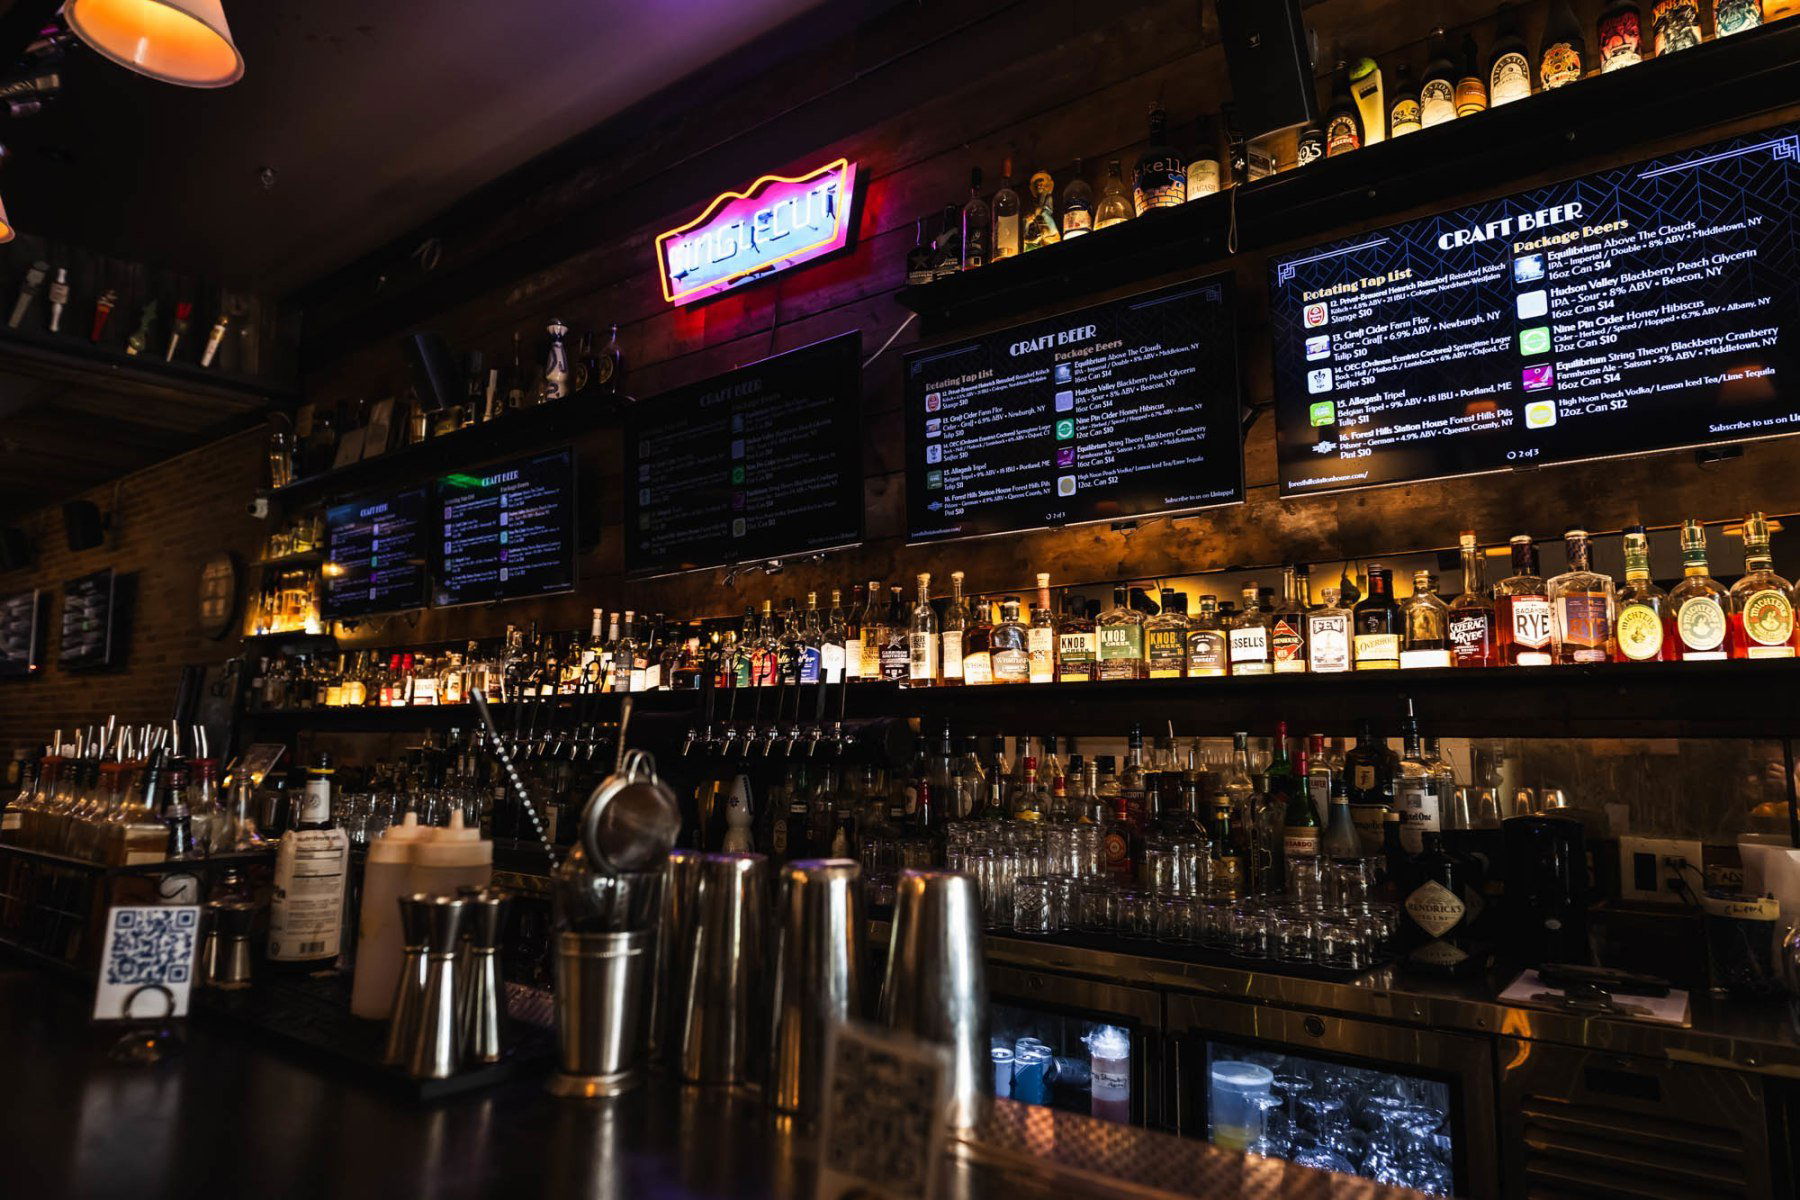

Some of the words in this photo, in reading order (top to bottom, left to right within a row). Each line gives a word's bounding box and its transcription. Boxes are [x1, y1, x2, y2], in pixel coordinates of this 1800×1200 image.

[1437, 217, 1513, 250] CRAFT
[1517, 201, 1583, 232] BEER
[1513, 230, 1580, 253] Package
[1582, 219, 1629, 238] Beers
[1547, 242, 1602, 260] Equilibrium
[1603, 235, 1636, 248] Above
[1636, 230, 1656, 240] The
[1657, 220, 1696, 236] Clouds
[1548, 270, 1570, 280] 16oz
[1571, 265, 1592, 275] Can
[1593, 259, 1611, 271] $14
[1549, 283, 1587, 297] Hudson
[1587, 277, 1618, 289] Valley
[1620, 266, 1674, 283] Blackberry
[1676, 257, 1709, 271] Peach
[1302, 280, 1359, 302] Rotating
[1358, 275, 1386, 288] Tap
[1387, 267, 1412, 282] List
[1550, 296, 1570, 308] IPA
[1577, 292, 1601, 303] Sour
[1609, 285, 1627, 296] 8%
[1628, 279, 1653, 293] ABV
[1661, 272, 1704, 286] Beacon,
[1705, 265, 1722, 277] NY
[1551, 309, 1573, 319] 16oz
[1574, 304, 1595, 314] Can
[1596, 298, 1615, 311] $14
[1552, 324, 1576, 334] Nine
[1577, 319, 1594, 330] Pin
[1595, 314, 1625, 326] Cider
[1626, 308, 1659, 320] Honey
[1660, 300, 1705, 314] Hibiscus
[1009, 333, 1055, 356] CRAFT
[1057, 324, 1096, 345] BEER
[1332, 341, 1355, 351] Cider
[1411, 323, 1432, 336] ABV
[1438, 314, 1485, 330] Newburgh,
[1486, 310, 1501, 321] NY
[1054, 346, 1094, 361] Package
[1095, 339, 1123, 352] Beers
[1554, 343, 1575, 352] 12oz
[1576, 338, 1598, 348] Can
[1599, 333, 1617, 345] $10
[1555, 356, 1607, 371] Equilibrium
[1607, 351, 1635, 362] String
[1636, 345, 1669, 356] Theory
[1670, 336, 1724, 351] Blackberry
[1724, 327, 1778, 341] Cranberry
[1333, 351, 1352, 361] Tulip
[1352, 347, 1368, 358] $10
[1557, 381, 1579, 390] 16oz
[1579, 376, 1601, 386] Can
[1602, 372, 1621, 383] $14
[1336, 399, 1347, 408] 15.
[1348, 392, 1382, 406] Allagash
[1382, 388, 1405, 400] Tripel
[1337, 408, 1364, 417] Belgian
[1363, 402, 1384, 413] Tripel
[1389, 400, 1403, 409] 9%
[1403, 396, 1422, 406] ABV
[1427, 394, 1437, 402] 18
[1437, 390, 1453, 401] IBU
[1459, 384, 1496, 397] Portland,
[1496, 381, 1512, 391] ME
[1585, 403, 1608, 413] Can
[1609, 398, 1628, 410] $12
[1337, 417, 1357, 427] Tulip
[1357, 414, 1369, 424] $11
[1338, 431, 1350, 441] 16.
[1349, 429, 1374, 440] Forest
[1374, 426, 1393, 436] Hills
[1393, 423, 1421, 433] Station
[1421, 419, 1448, 429] House
[1449, 414, 1475, 425] Forest
[1476, 410, 1495, 421] Hills
[1496, 408, 1513, 417] Pils
[1709, 420, 1751, 432] Subscribe
[1752, 419, 1762, 427] to
[1101, 629, 1126, 643] KNOB
[1516, 614, 1549, 638] RYE
[1061, 637, 1085, 649] KNOB
[1150, 631, 1176, 645] KNOB
[1232, 636, 1265, 649] SSELL'S
